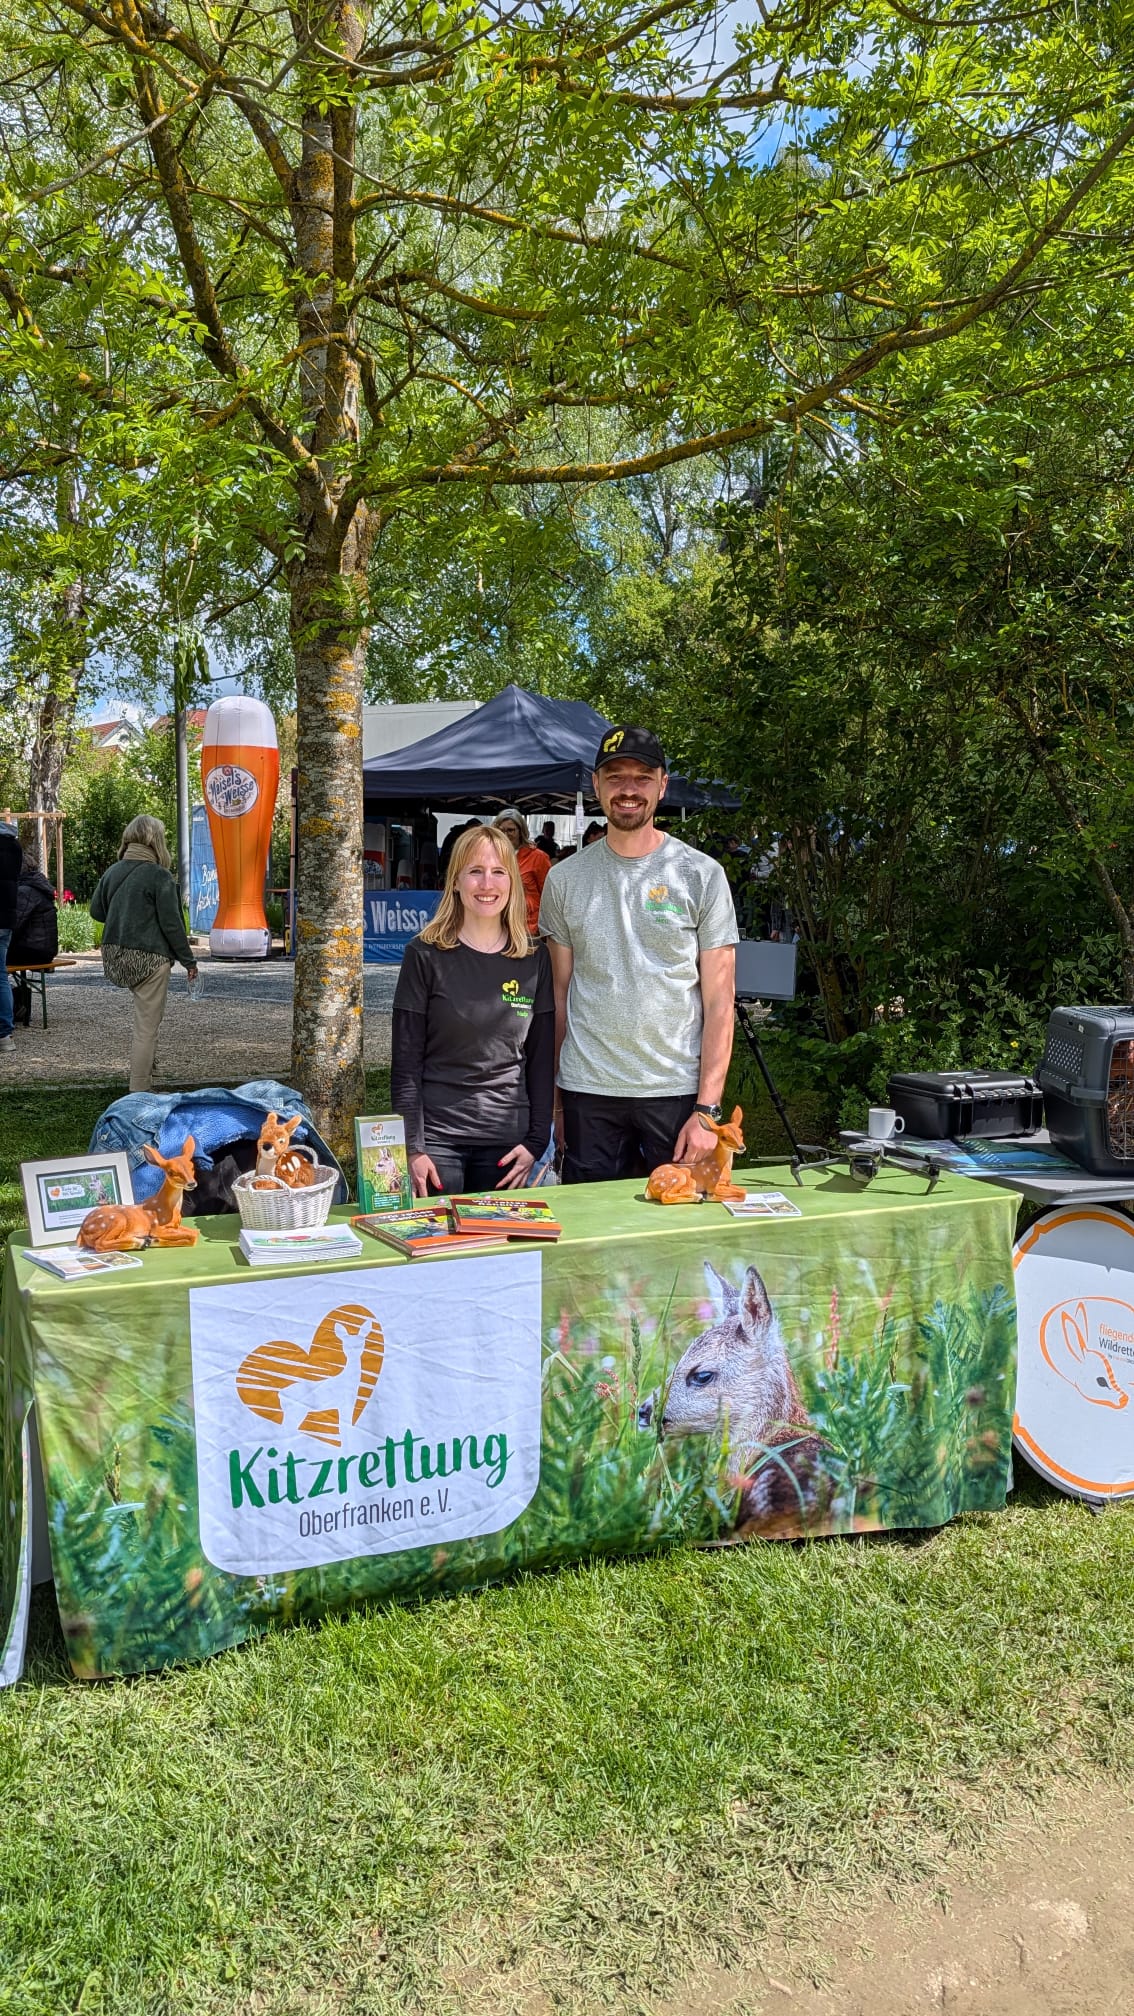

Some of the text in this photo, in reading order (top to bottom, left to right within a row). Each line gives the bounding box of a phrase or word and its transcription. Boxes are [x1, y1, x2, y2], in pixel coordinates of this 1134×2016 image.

[224, 780, 255, 806] Weisse
[370, 900, 429, 934] Weisse
[229, 1428, 516, 1510] Kitzrettung
[299, 1497, 414, 1538] Oberfranken
